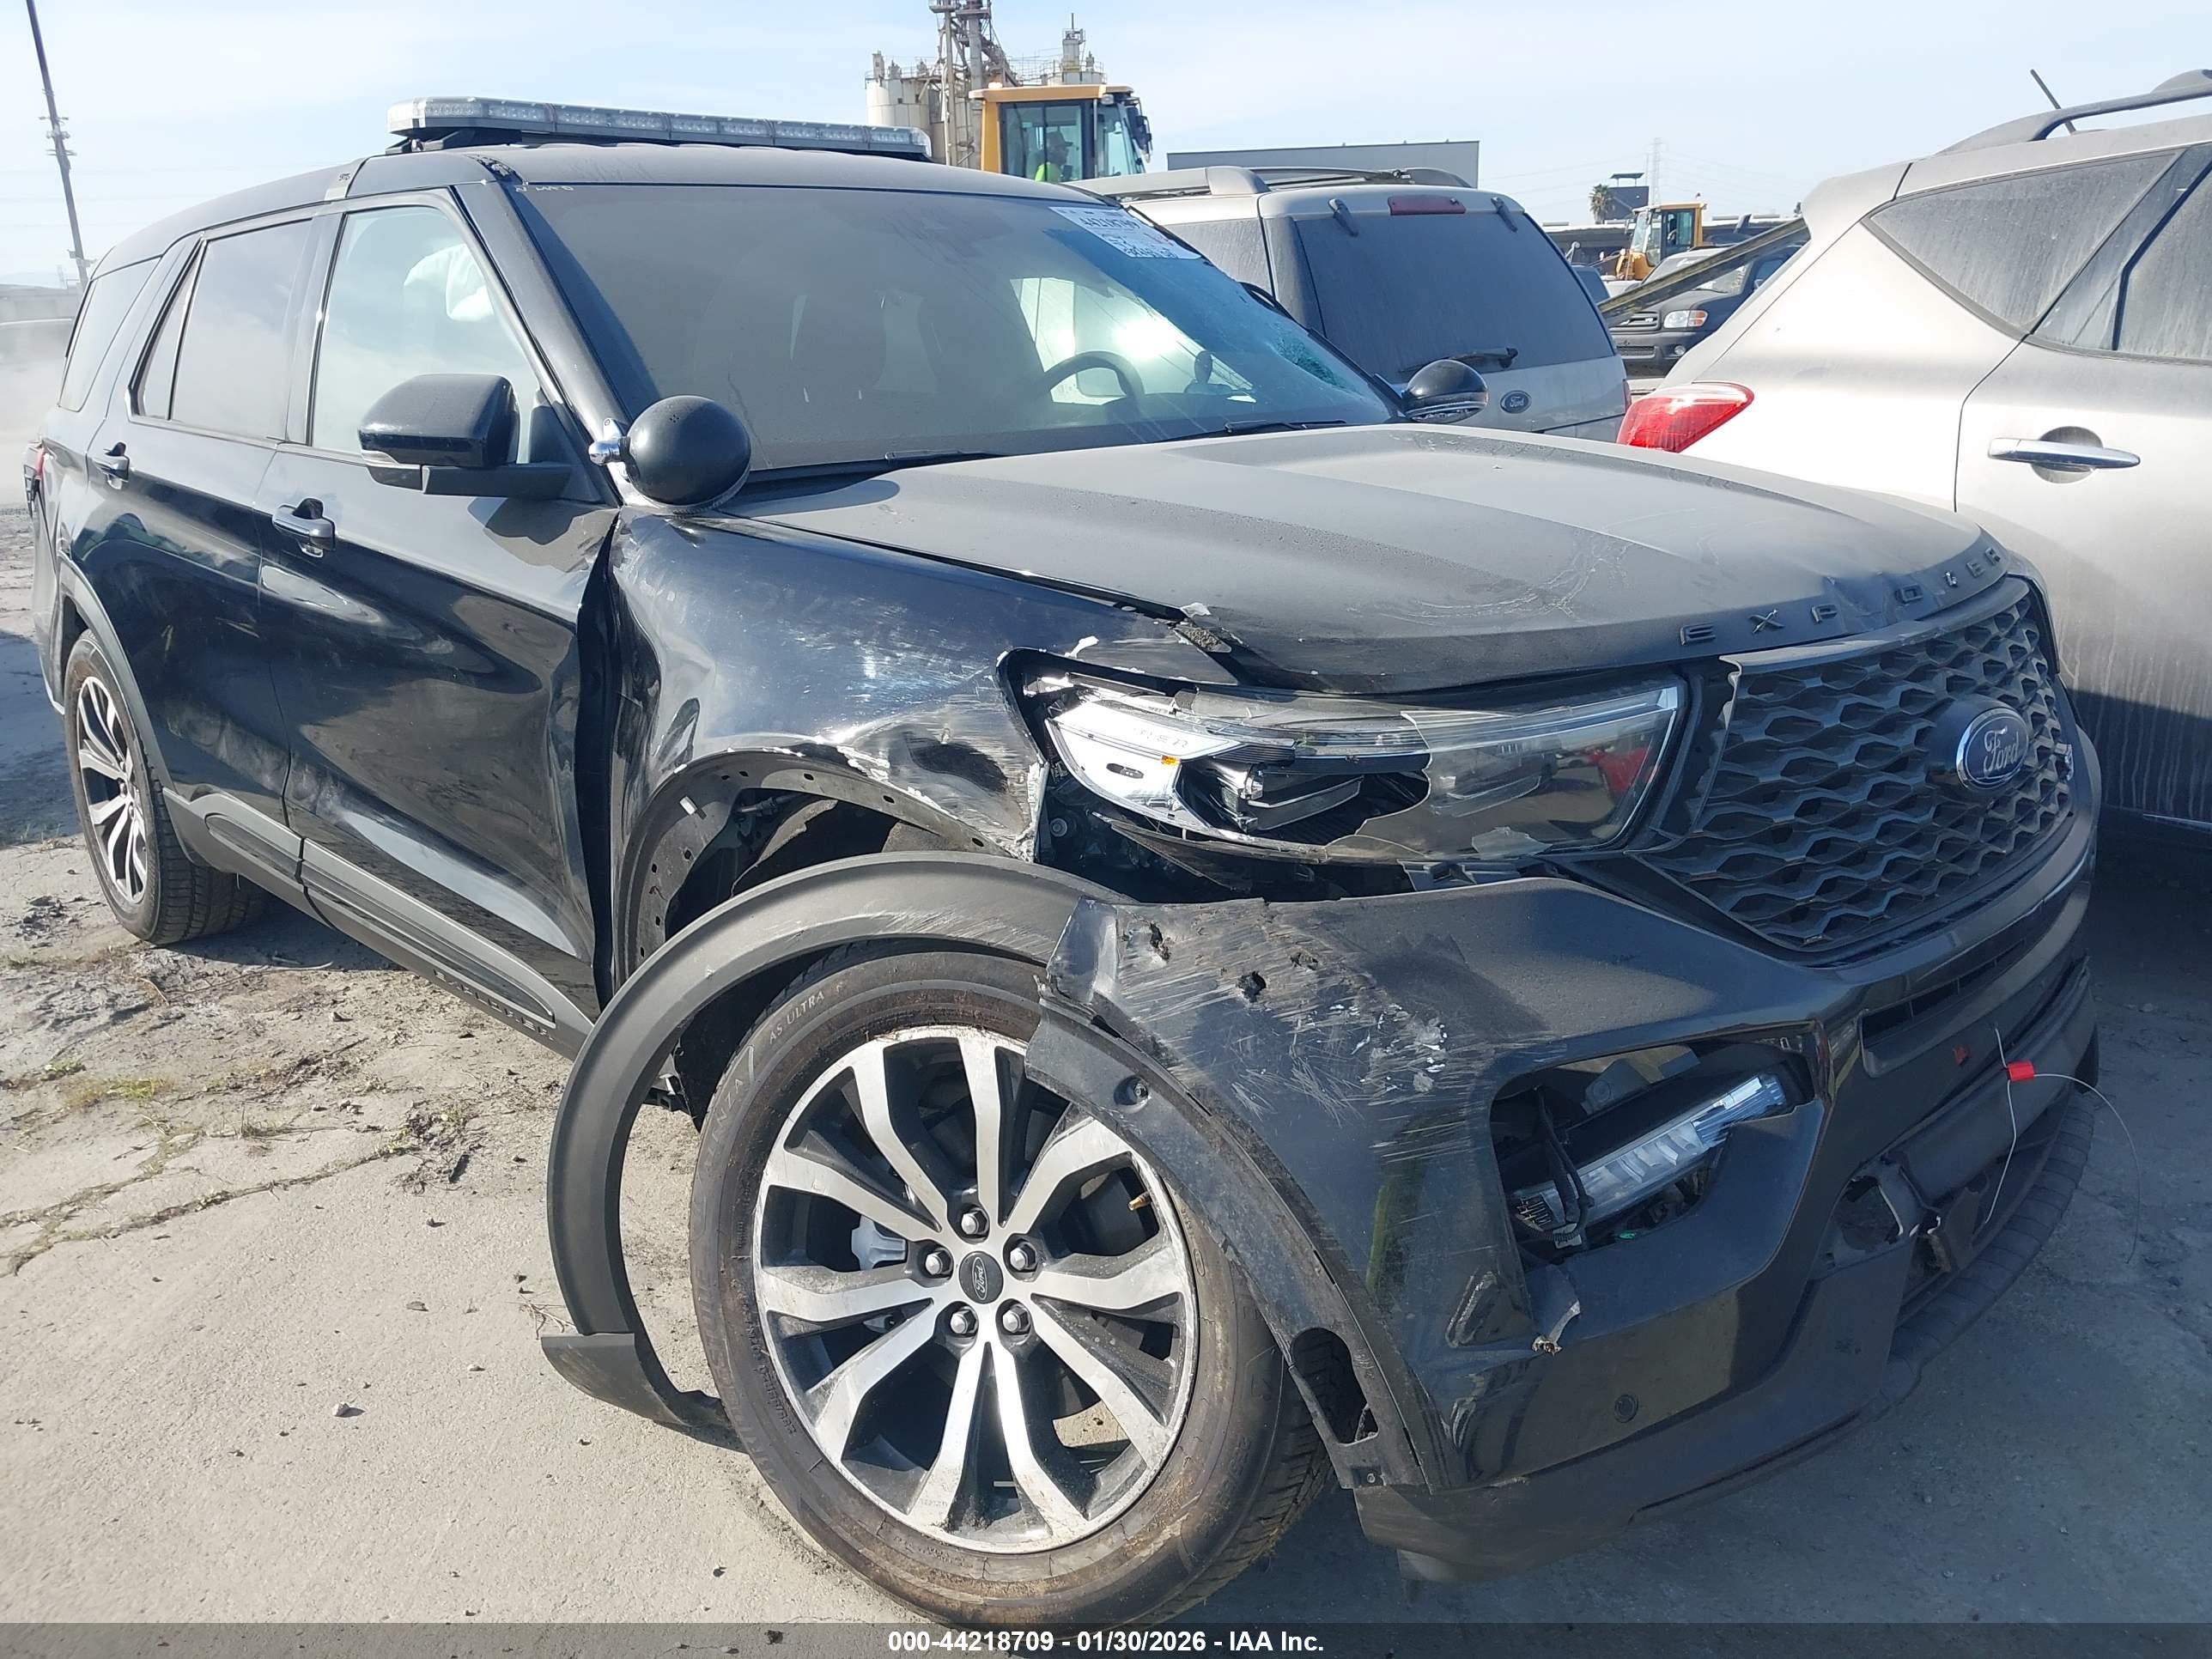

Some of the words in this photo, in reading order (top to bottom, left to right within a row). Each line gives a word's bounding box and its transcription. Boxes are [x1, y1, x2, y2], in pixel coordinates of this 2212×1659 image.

[1983, 726, 2020, 778] Ford
[769, 1023, 784, 1045] AS
[787, 990, 825, 1024] ULTRA
